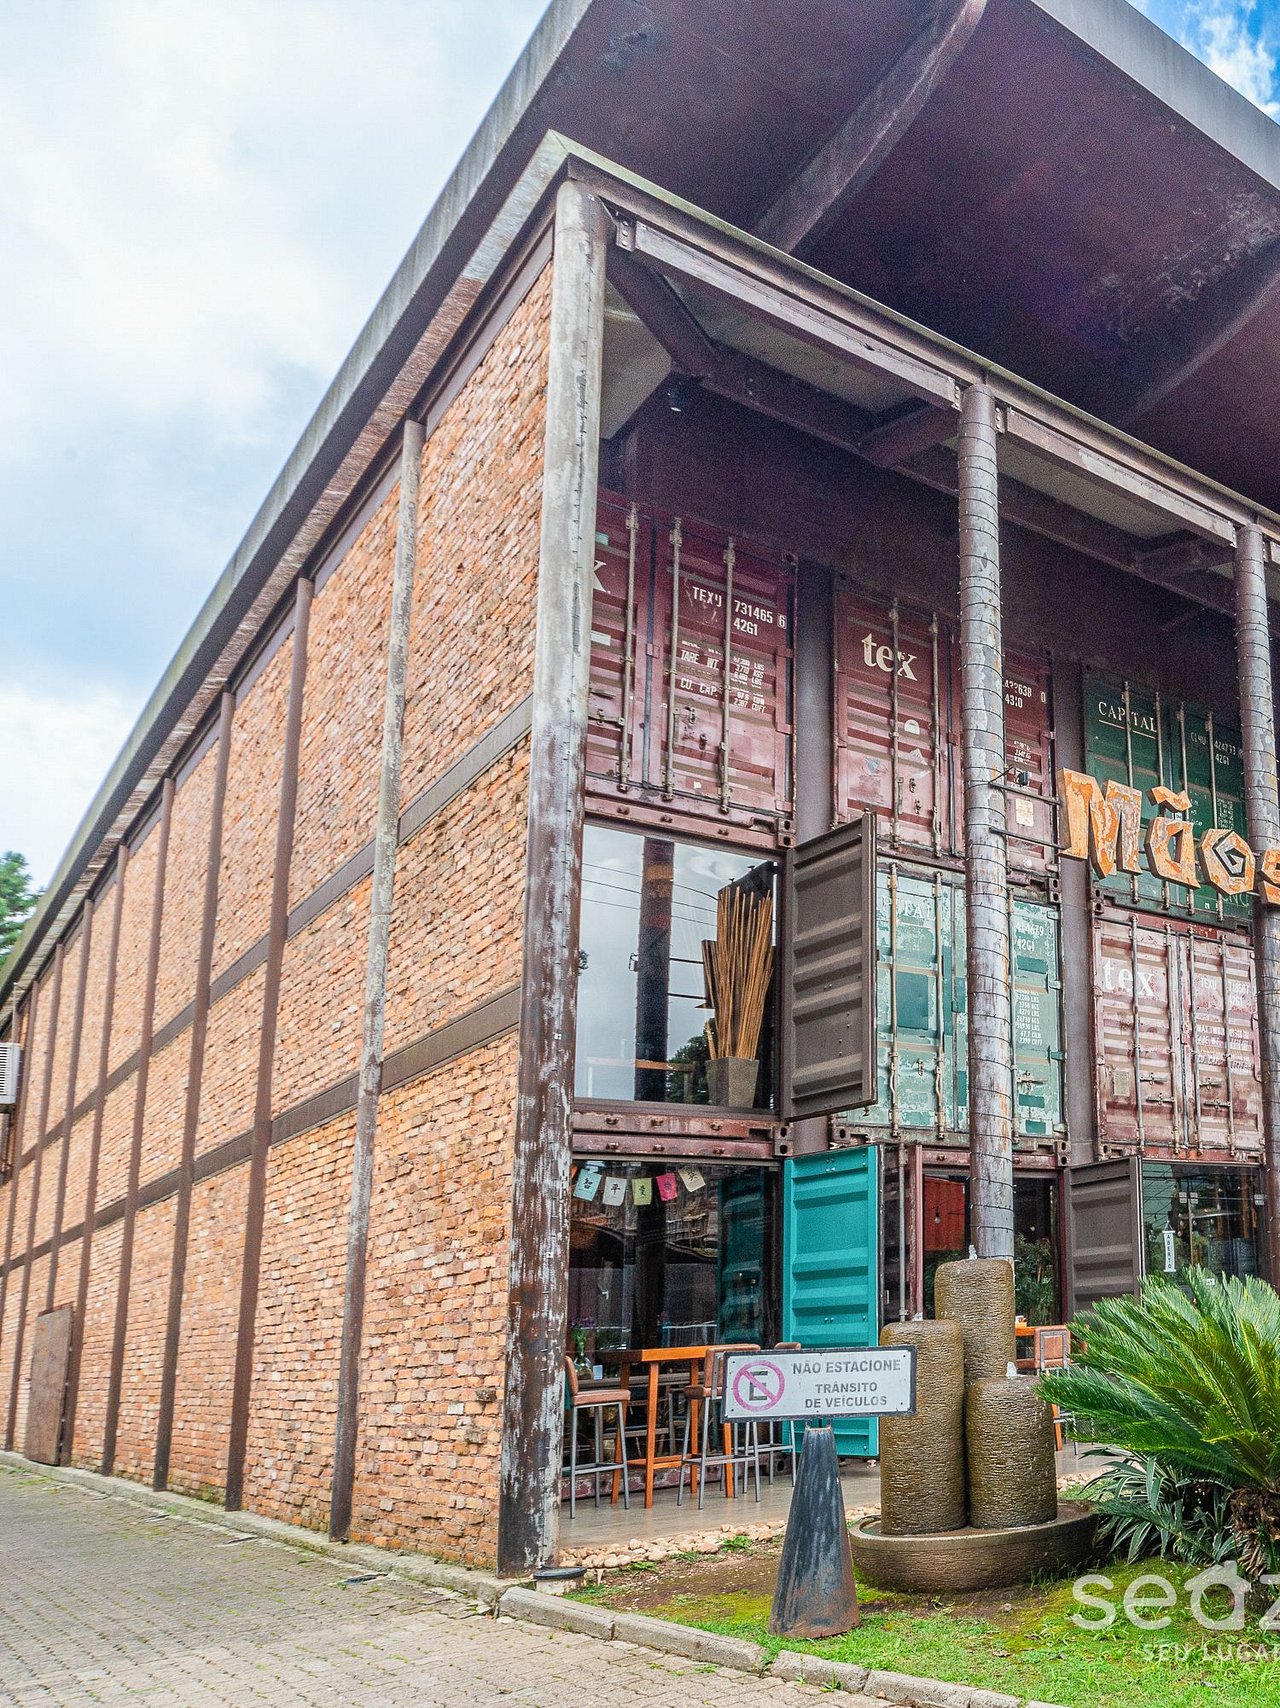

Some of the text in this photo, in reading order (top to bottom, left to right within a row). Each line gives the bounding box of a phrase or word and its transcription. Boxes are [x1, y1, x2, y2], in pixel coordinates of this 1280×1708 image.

[734, 600, 773, 624] 731465
[778, 614, 785, 628] 6
[861, 633, 917, 681] tex
[1098, 701, 1157, 733] CAPTAL
[1103, 960, 1155, 997] tex
[792, 1359, 901, 1375] NÃO ESTACIONE
[815, 1381, 878, 1394] TRÂNSITO
[805, 1395, 888, 1409] DE VEÍCULOS
